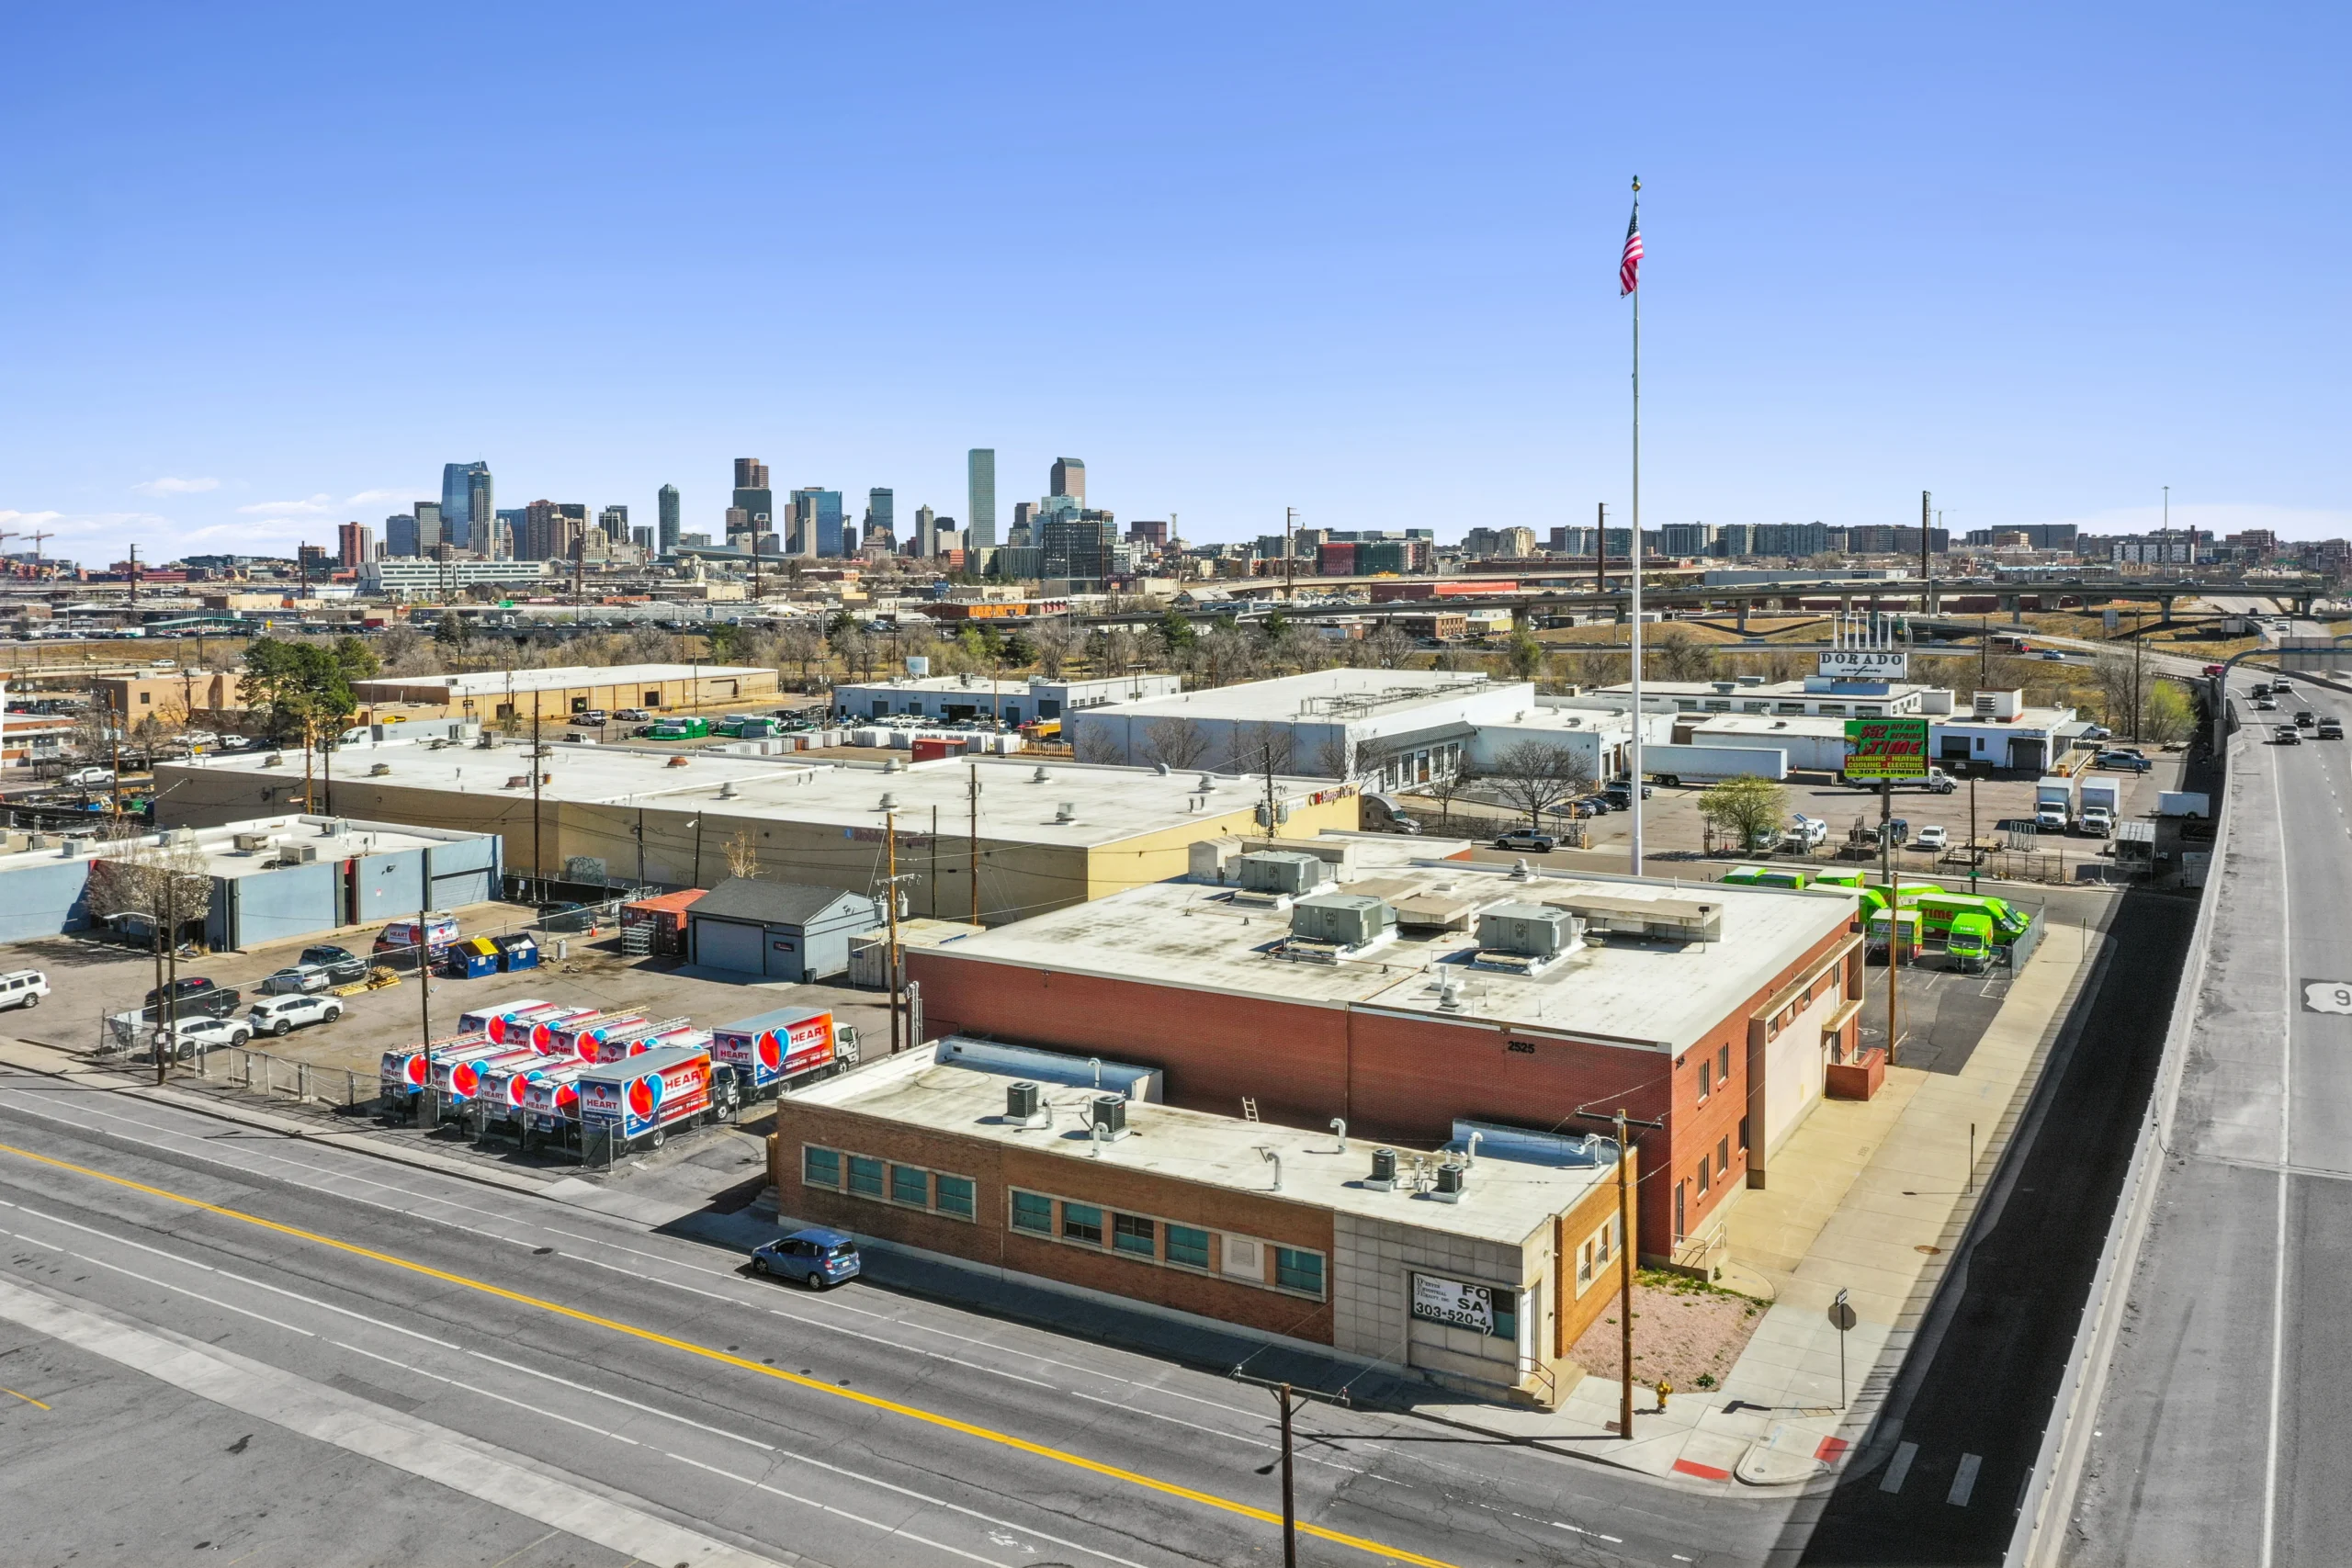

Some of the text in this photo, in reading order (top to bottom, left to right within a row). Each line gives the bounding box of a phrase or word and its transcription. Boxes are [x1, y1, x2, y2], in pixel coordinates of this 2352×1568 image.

[1820, 653, 1902, 665] DORADO
[1860, 724, 1889, 739] $52
[1870, 739, 1923, 754] TIME
[1922, 908, 1953, 919] TIME
[790, 1024, 829, 1044] HEART
[506, 1038, 527, 1047] HEART
[1508, 1041, 1535, 1054] 2525
[551, 1044, 571, 1055] HEART
[720, 1049, 750, 1060] HEART
[384, 1067, 401, 1077] HEART
[431, 1078, 447, 1088] EART
[664, 1066, 707, 1090] HEART
[481, 1089, 504, 1099] HEART
[526, 1100, 549, 1111] HEART
[586, 1098, 618, 1110] HEART
